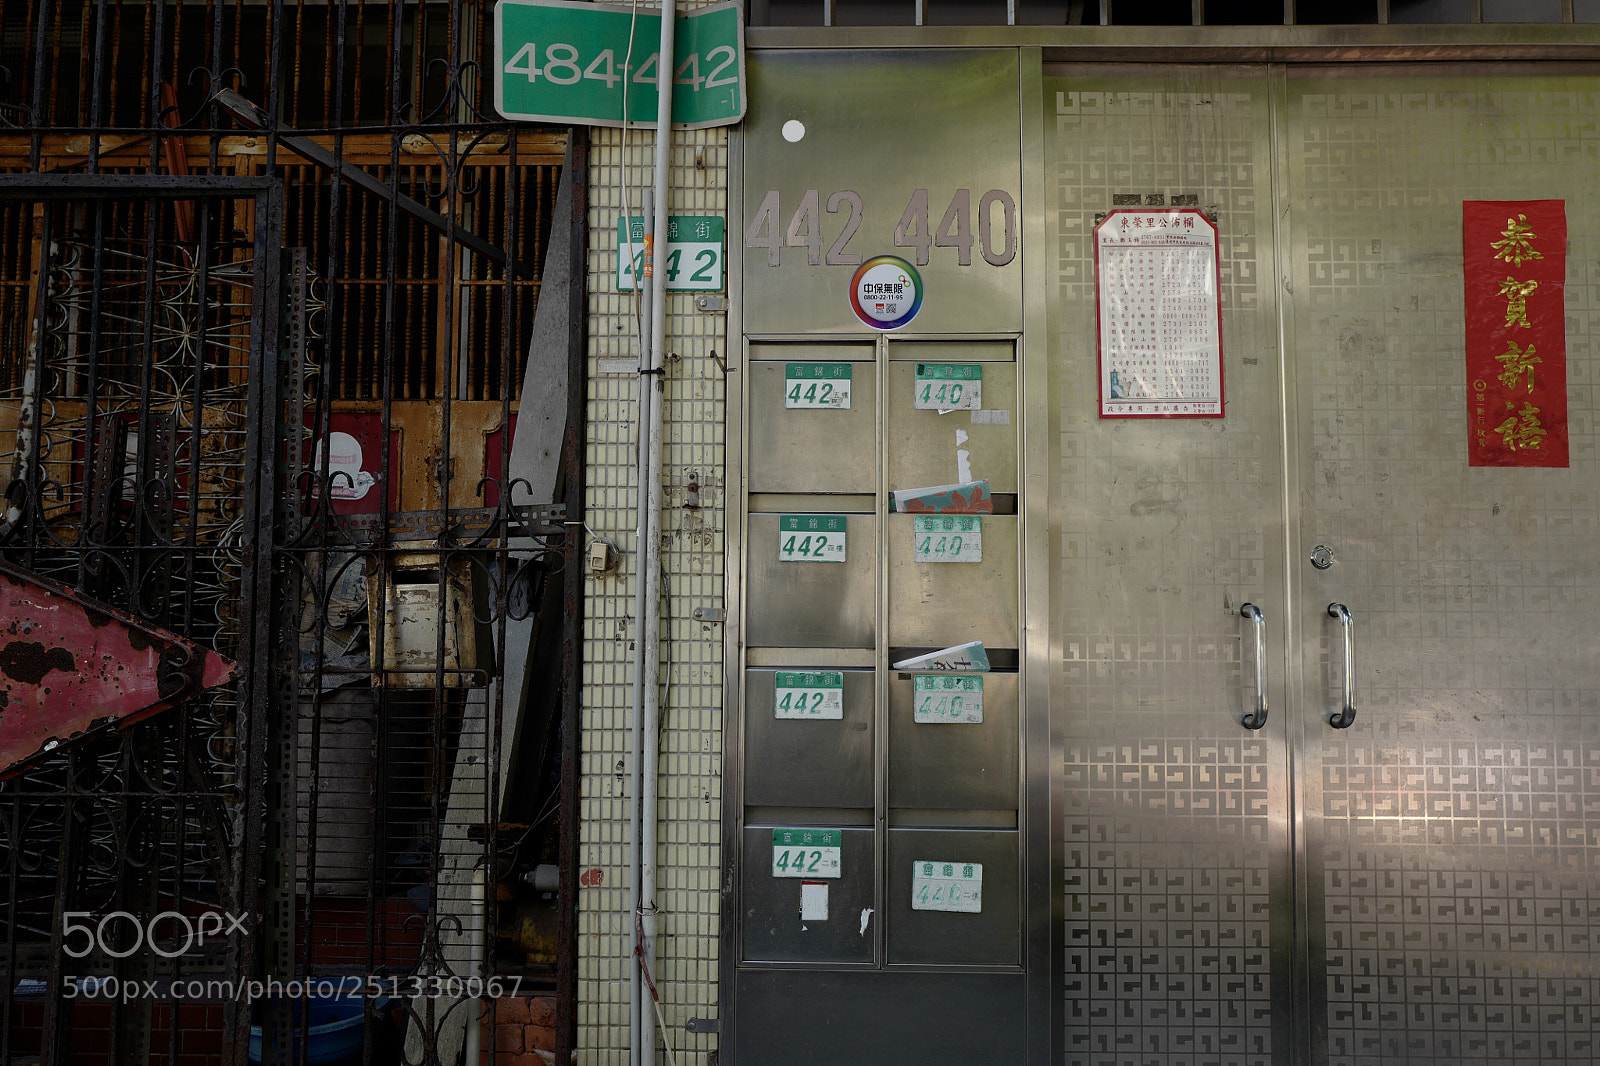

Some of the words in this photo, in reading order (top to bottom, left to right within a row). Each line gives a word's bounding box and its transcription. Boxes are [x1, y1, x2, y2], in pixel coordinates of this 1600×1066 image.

[504, 43, 738, 91] 484-442
[745, 190, 864, 267] 442
[894, 189, 1018, 267] 440
[624, 249, 717, 282] 442
[864, 283, 903, 294] 中保無限
[1490, 213, 1548, 452] 恭賀新禧
[788, 383, 834, 404] 442
[919, 383, 963, 404] 440
[782, 535, 828, 557] 442
[918, 536, 962, 557] 440
[778, 692, 824, 714] 442
[918, 696, 963, 717] 440
[776, 850, 822, 873] 442
